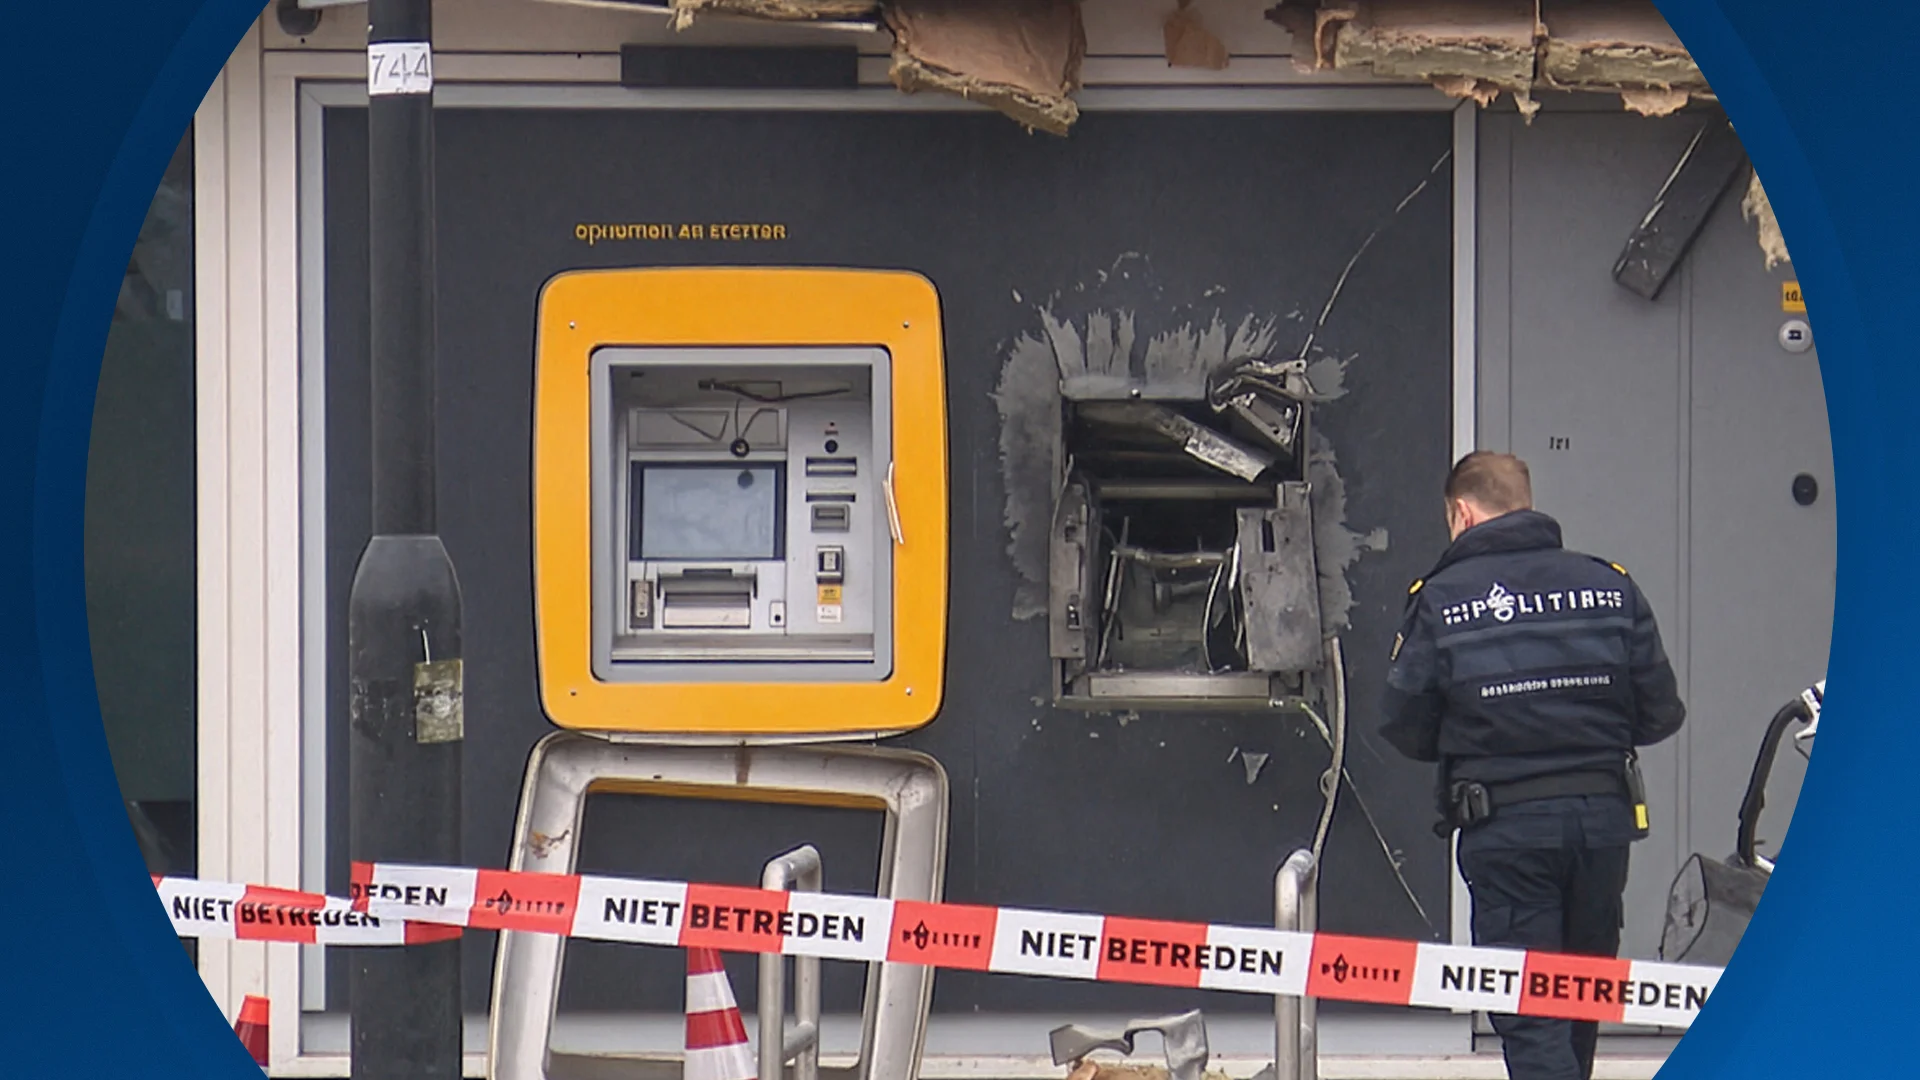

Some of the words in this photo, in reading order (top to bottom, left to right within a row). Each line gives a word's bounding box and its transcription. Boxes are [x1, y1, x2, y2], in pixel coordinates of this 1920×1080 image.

[173, 895, 233, 922] NIET
[603, 897, 680, 927] NIET
[689, 903, 865, 942] BETREDEN
[1020, 929, 1097, 960] NIET
[1106, 937, 1283, 976] BETREDEN
[1440, 964, 1519, 996] NIET
[1528, 972, 1708, 1011] BETREDEN
